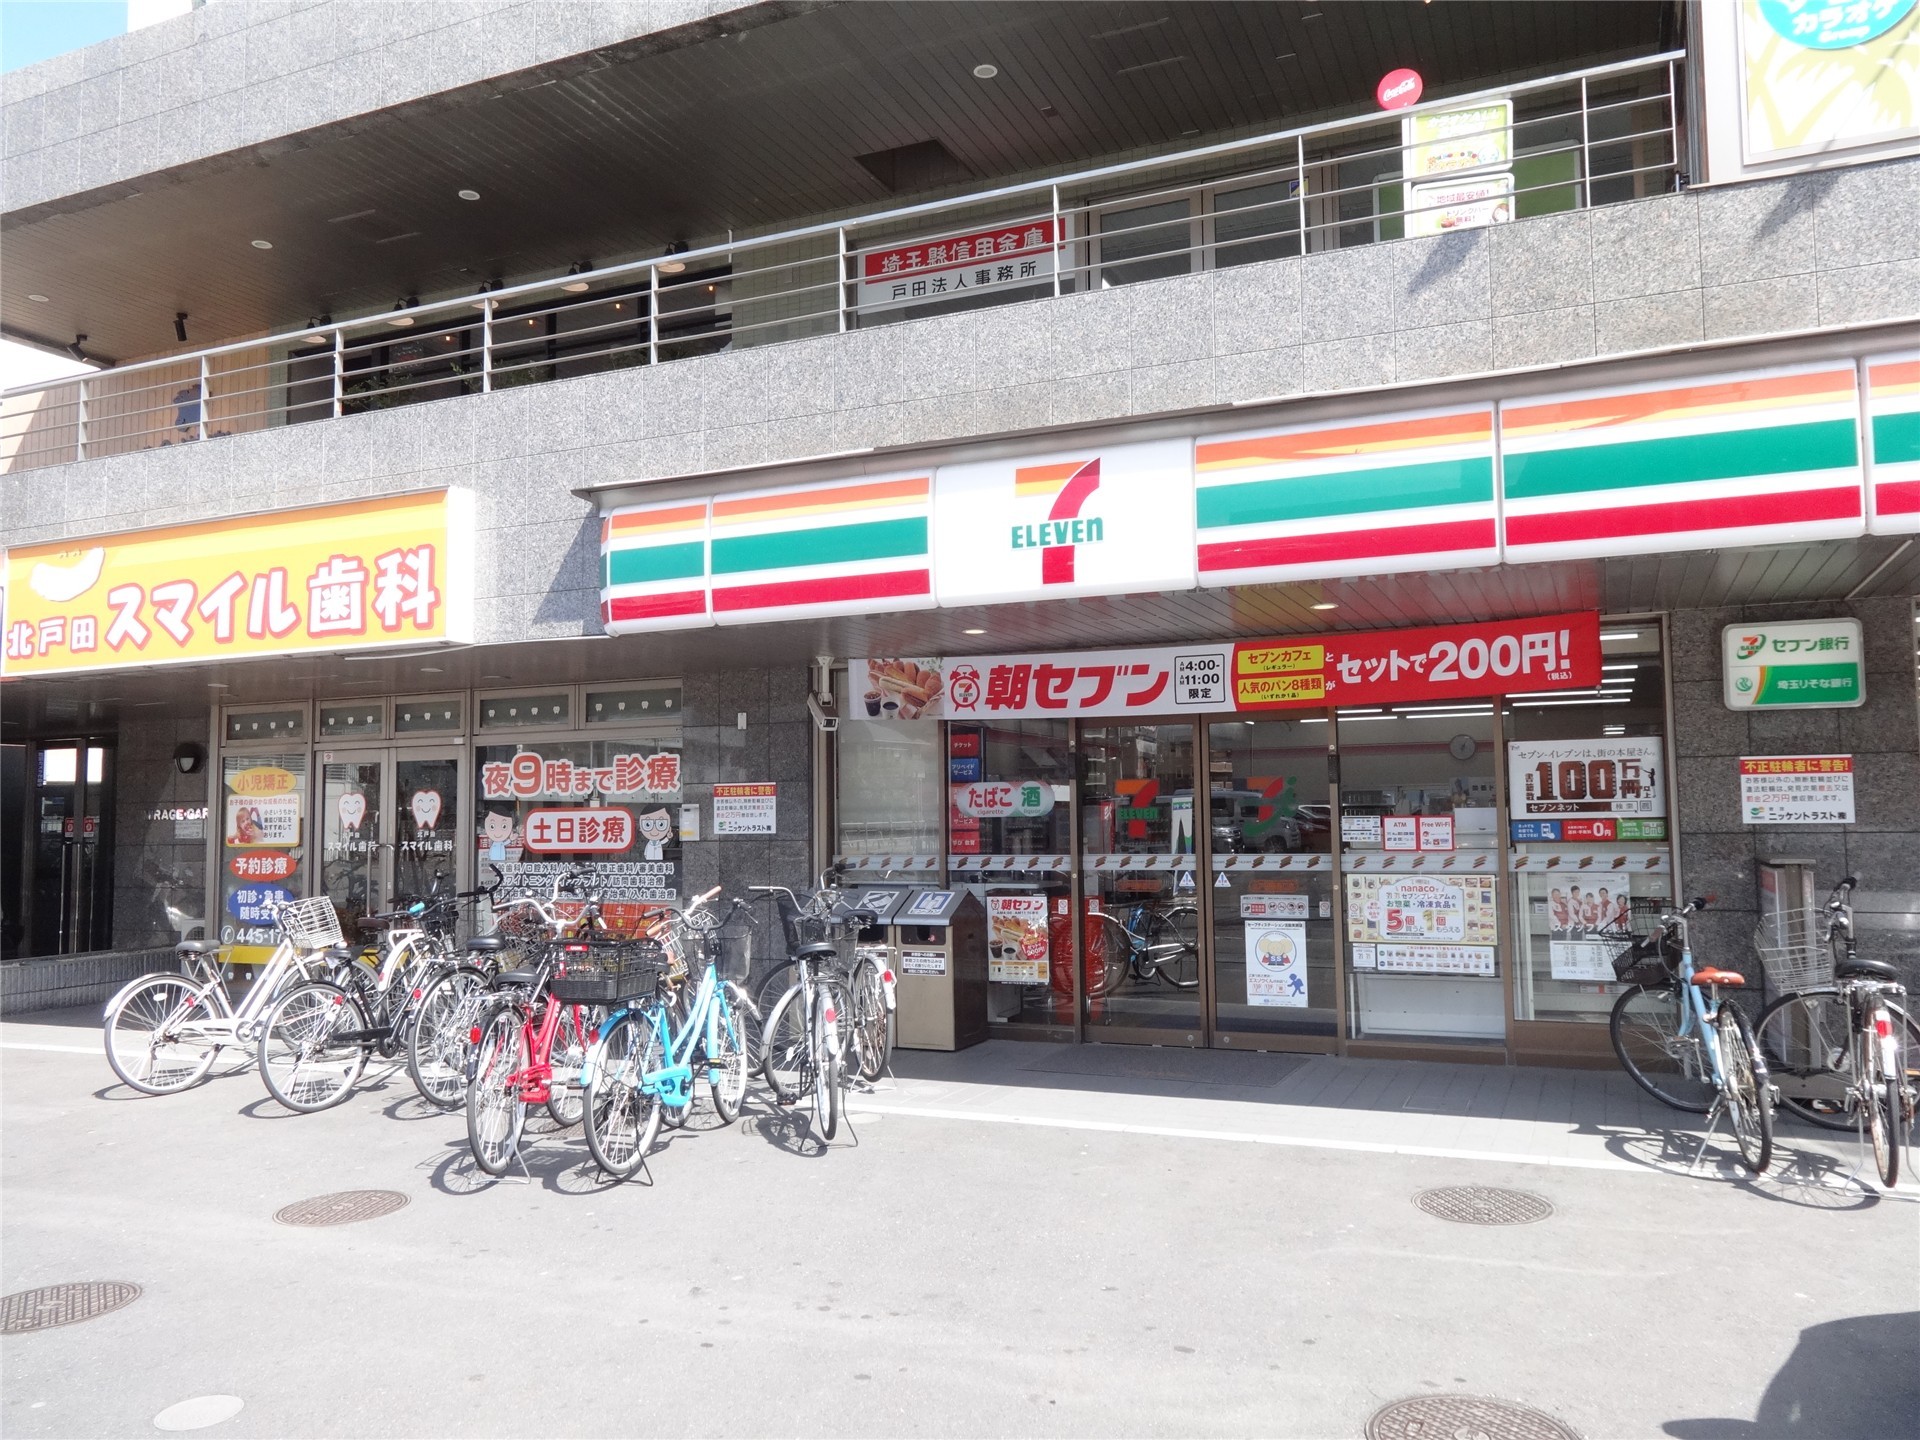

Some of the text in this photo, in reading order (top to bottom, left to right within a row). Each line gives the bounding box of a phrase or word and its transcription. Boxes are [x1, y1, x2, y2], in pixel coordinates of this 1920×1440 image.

[881, 227, 1048, 273] 埼玉縣信用金庫
[891, 260, 1037, 301] 戸田法人事務所
[1771, 636, 1850, 653] セブン銀行
[1247, 650, 1312, 665] セブンカフェ
[1325, 652, 1334, 662] と
[984, 663, 1170, 712] 朝セブン
[1185, 673, 1220, 685] 11:00
[1239, 677, 1322, 694] 人気のパン8種類
[1325, 680, 1336, 691] が
[1777, 677, 1853, 690] 埼玉りそな銀行
[1188, 687, 1212, 699] 限定
[1744, 759, 1849, 773] 不正駐輪者に警告!
[237, 773, 289, 791] 小児矯正
[484, 754, 680, 796] 夜9時まで診療
[968, 786, 1013, 808] たばこ
[1021, 786, 1041, 807] 酒
[1529, 803, 1580, 812] セブンネット
[531, 816, 626, 844] 土日診療
[401, 840, 453, 851] スマイル歯科
[235, 857, 288, 875] 予約診療
[1001, 899, 1044, 911] 朝セブン
